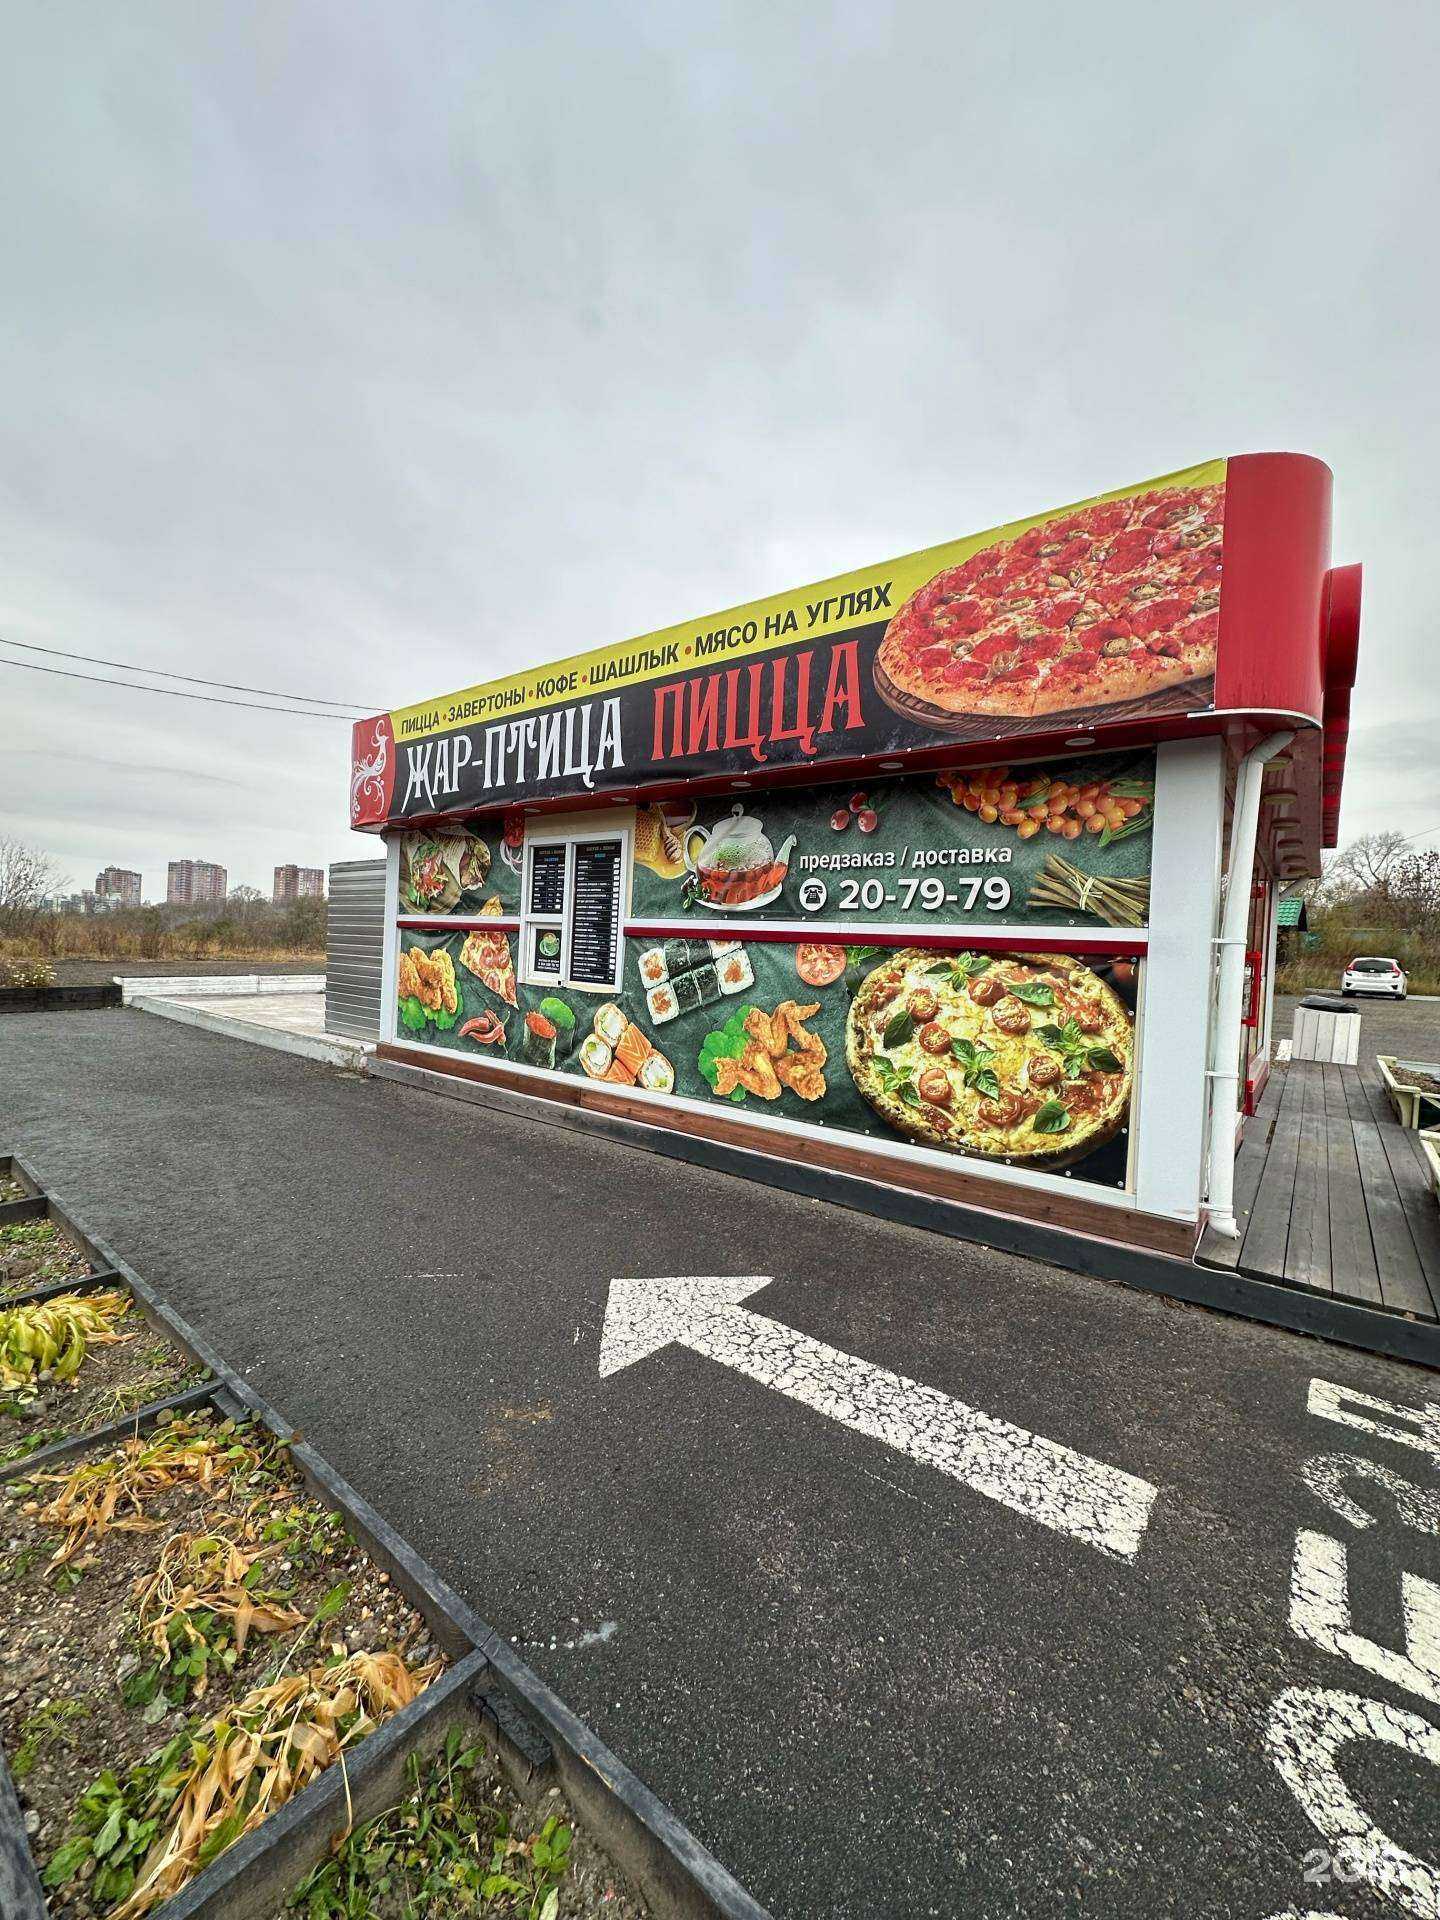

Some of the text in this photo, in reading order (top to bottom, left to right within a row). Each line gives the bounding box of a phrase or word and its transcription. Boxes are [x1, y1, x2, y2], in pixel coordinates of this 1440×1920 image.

[401, 581, 893, 735] ПИЦЦА ЗАВЕРТОНЫ КОФЕ ШАШЛЫК МЯСО НА УГЛЯХ
[401, 640, 866, 814] ЖАР-ПТИЦА ПИЦЦА
[800, 851, 895, 872] предзаказ
[912, 847, 1012, 868] доставка
[838, 876, 1012, 911] 20-79-79
